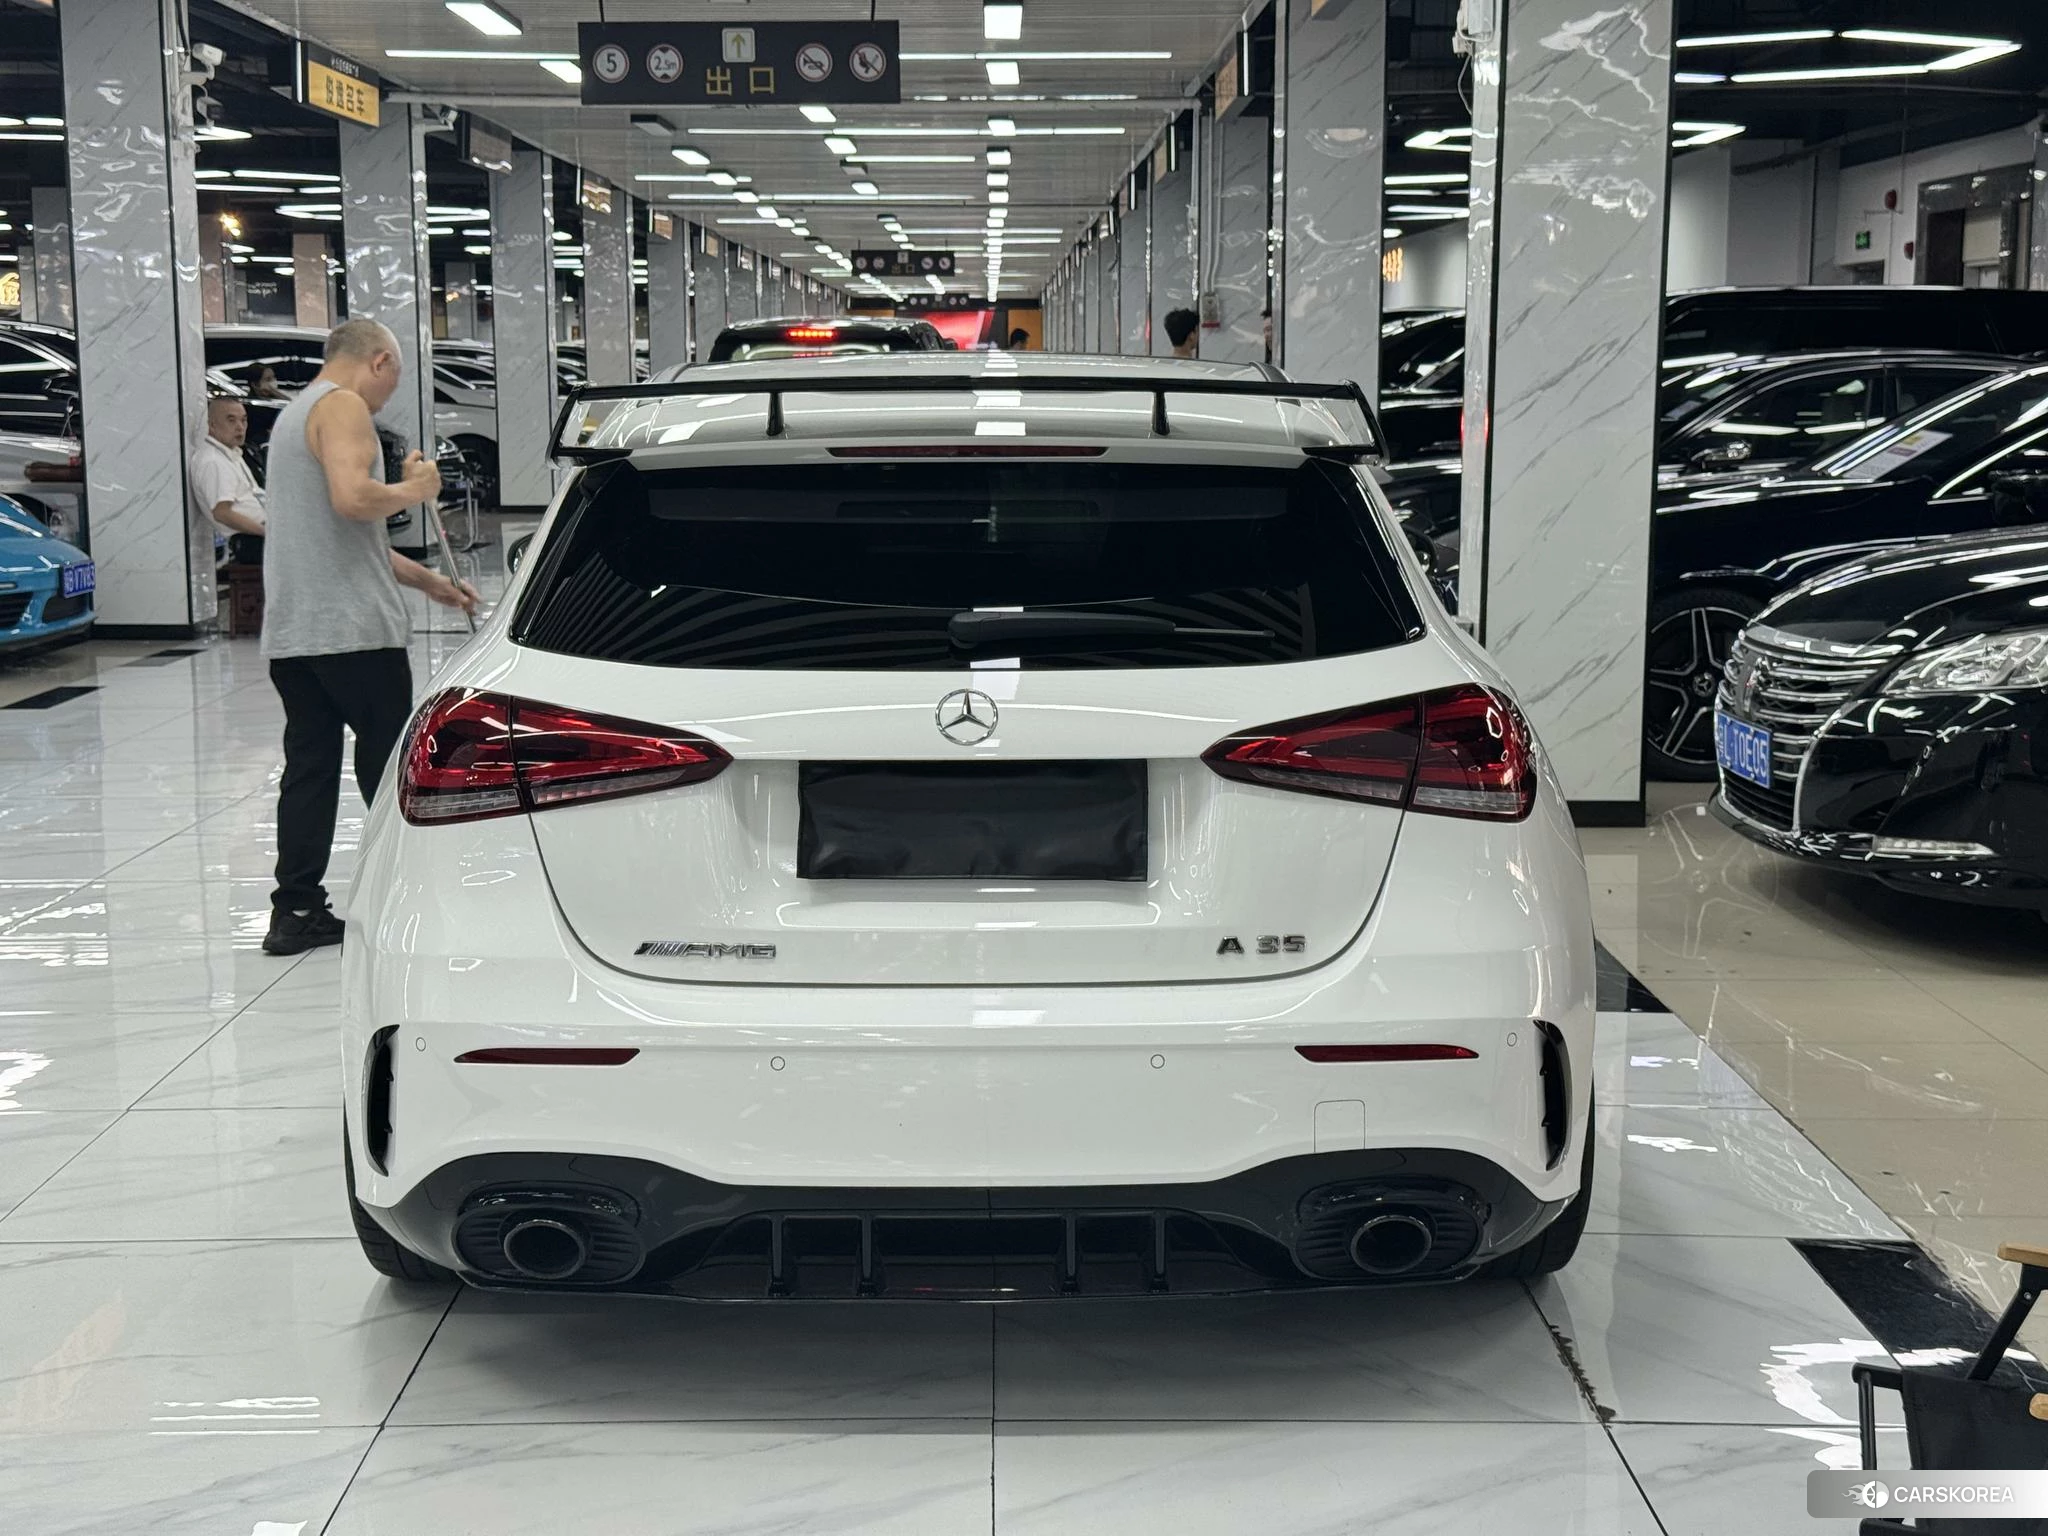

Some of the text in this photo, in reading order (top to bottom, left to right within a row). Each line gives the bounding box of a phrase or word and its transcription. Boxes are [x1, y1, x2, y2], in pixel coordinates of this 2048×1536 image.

[606, 53, 617, 73] 5
[653, 55, 677, 71] 2.5m
[706, 65, 775, 96] 出口
[1217, 934, 1306, 954] A 35
